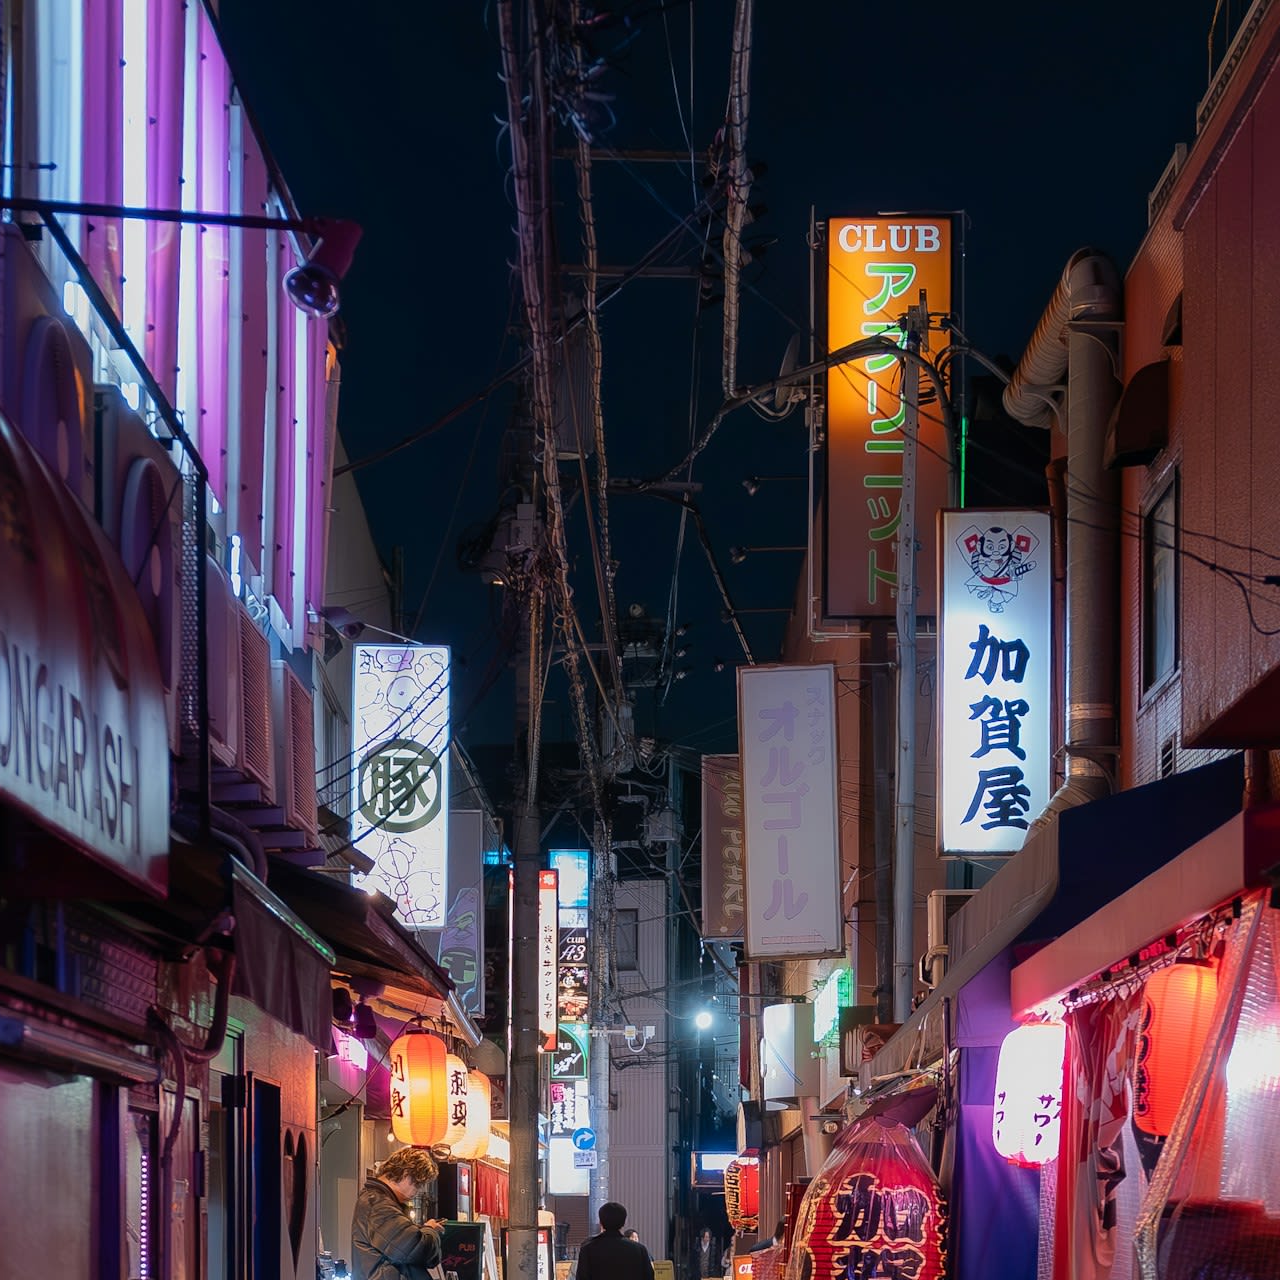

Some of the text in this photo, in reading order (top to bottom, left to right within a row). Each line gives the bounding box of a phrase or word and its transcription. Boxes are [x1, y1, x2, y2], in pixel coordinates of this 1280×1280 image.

[839, 224, 941, 253] CLUB
[960, 624, 1031, 830] 加賀屋
[758, 700, 810, 921] オルゴール
[566, 936, 586, 944] CLUB
[450, 1070, 468, 1127] 刺身
[1033, 1094, 1056, 1146] サワー
